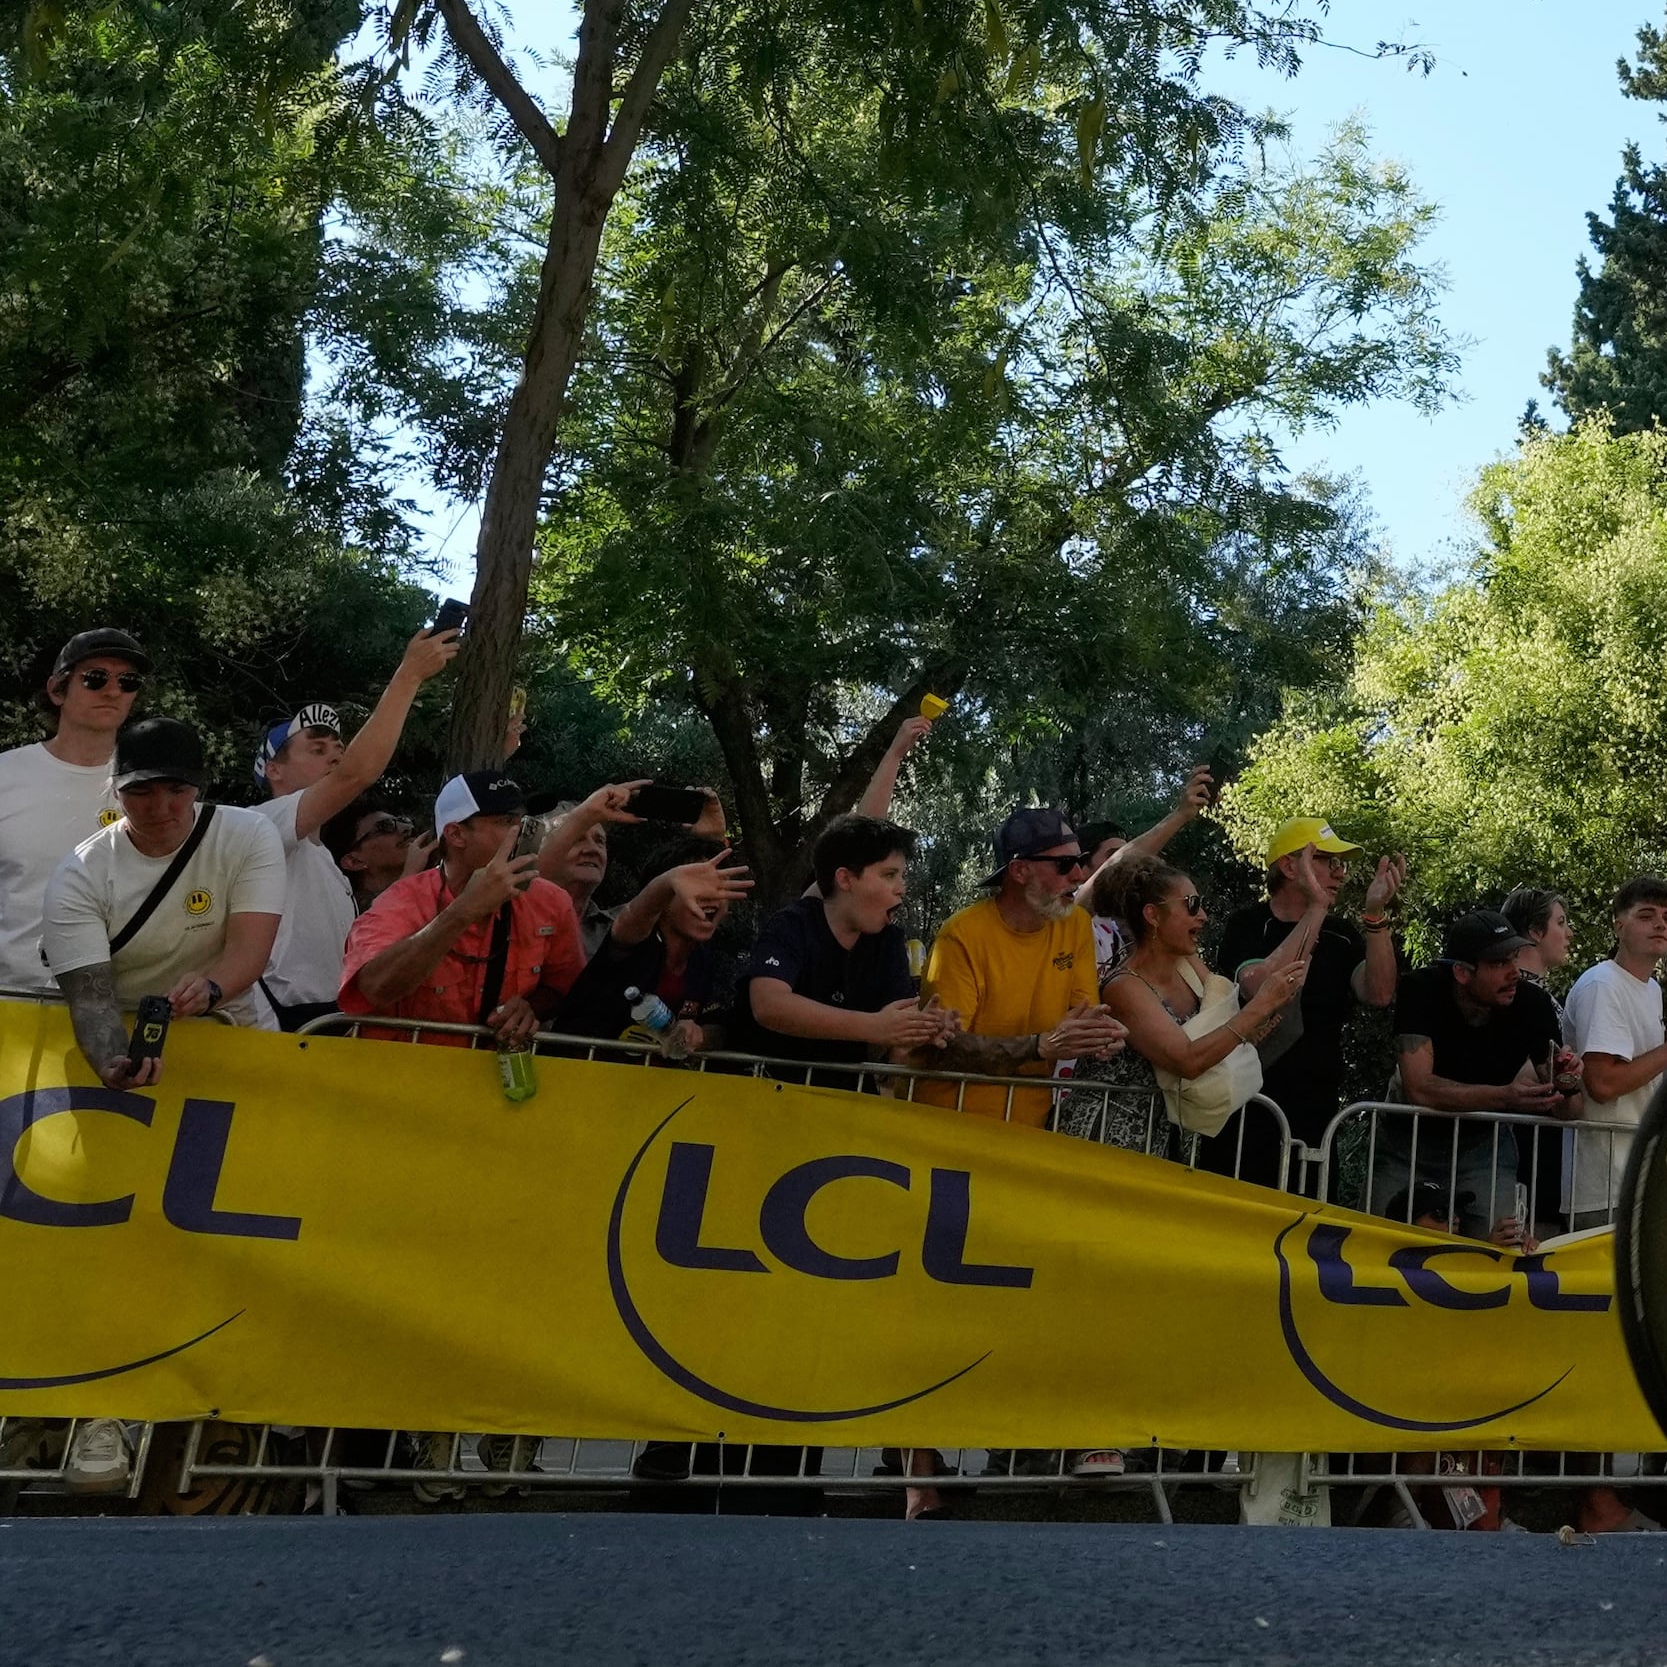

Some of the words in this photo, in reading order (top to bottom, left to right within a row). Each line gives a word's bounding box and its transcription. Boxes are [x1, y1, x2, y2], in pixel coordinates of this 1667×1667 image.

[0, 1086, 302, 1241] CL
[655, 1141, 1034, 1289] LCL
[1307, 1224, 1613, 1313] LCL
